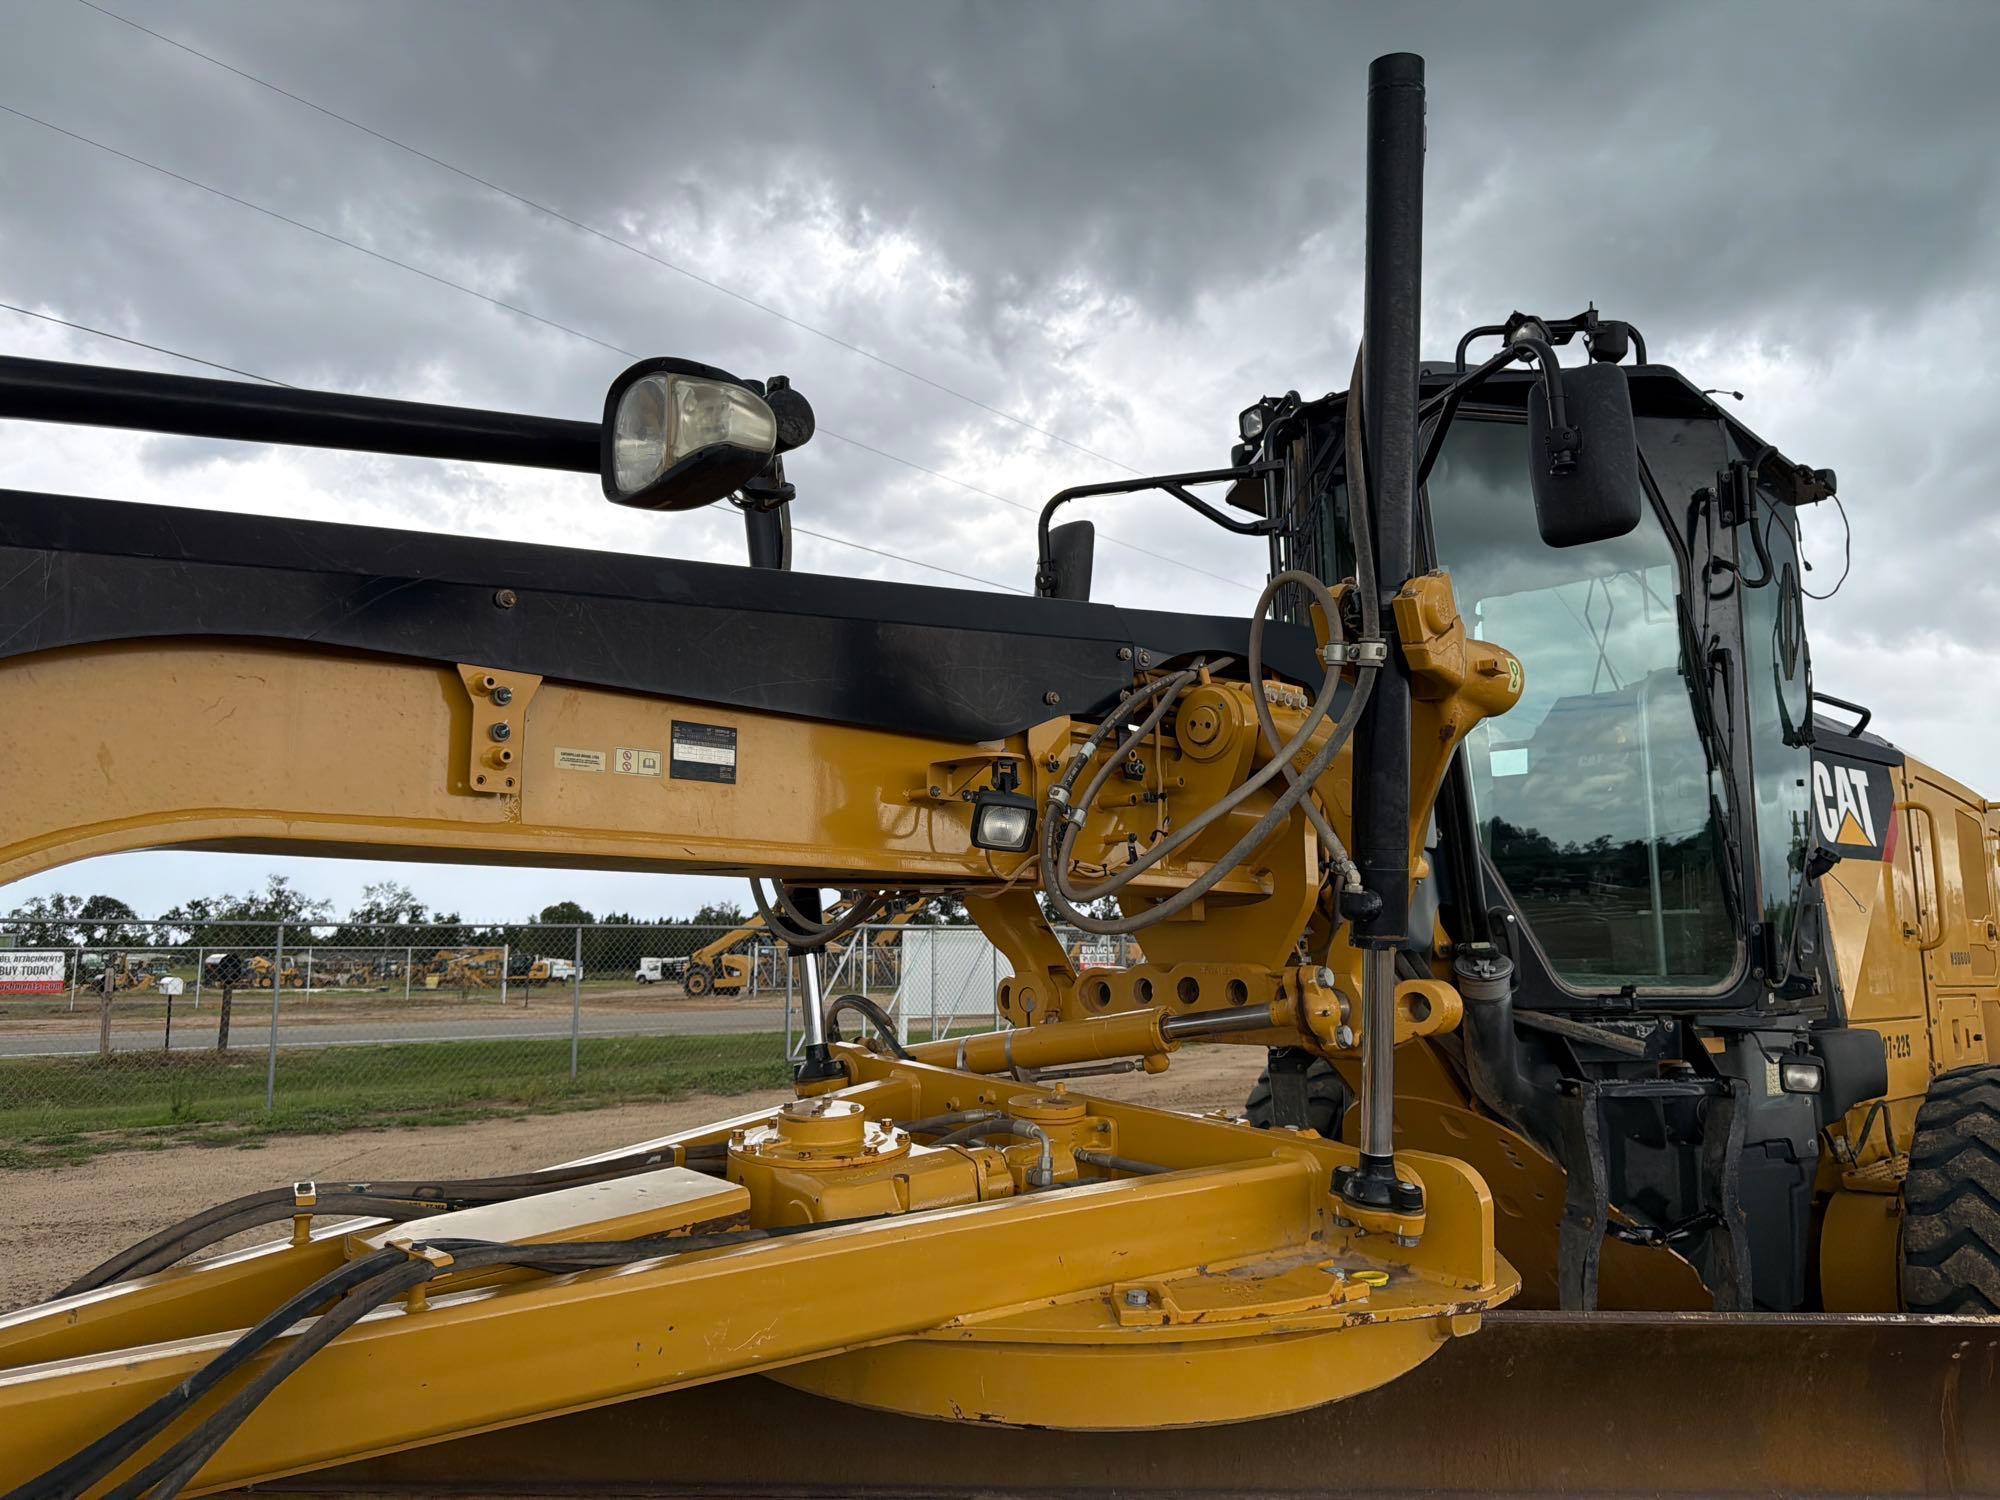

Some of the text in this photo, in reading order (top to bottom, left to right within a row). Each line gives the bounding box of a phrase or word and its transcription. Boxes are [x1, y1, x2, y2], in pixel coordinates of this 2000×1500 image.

[1813, 760, 1877, 848] CAT
[13, 955, 63, 963] ATTACHMENTS
[0, 965, 54, 976] BUY TODAY!
